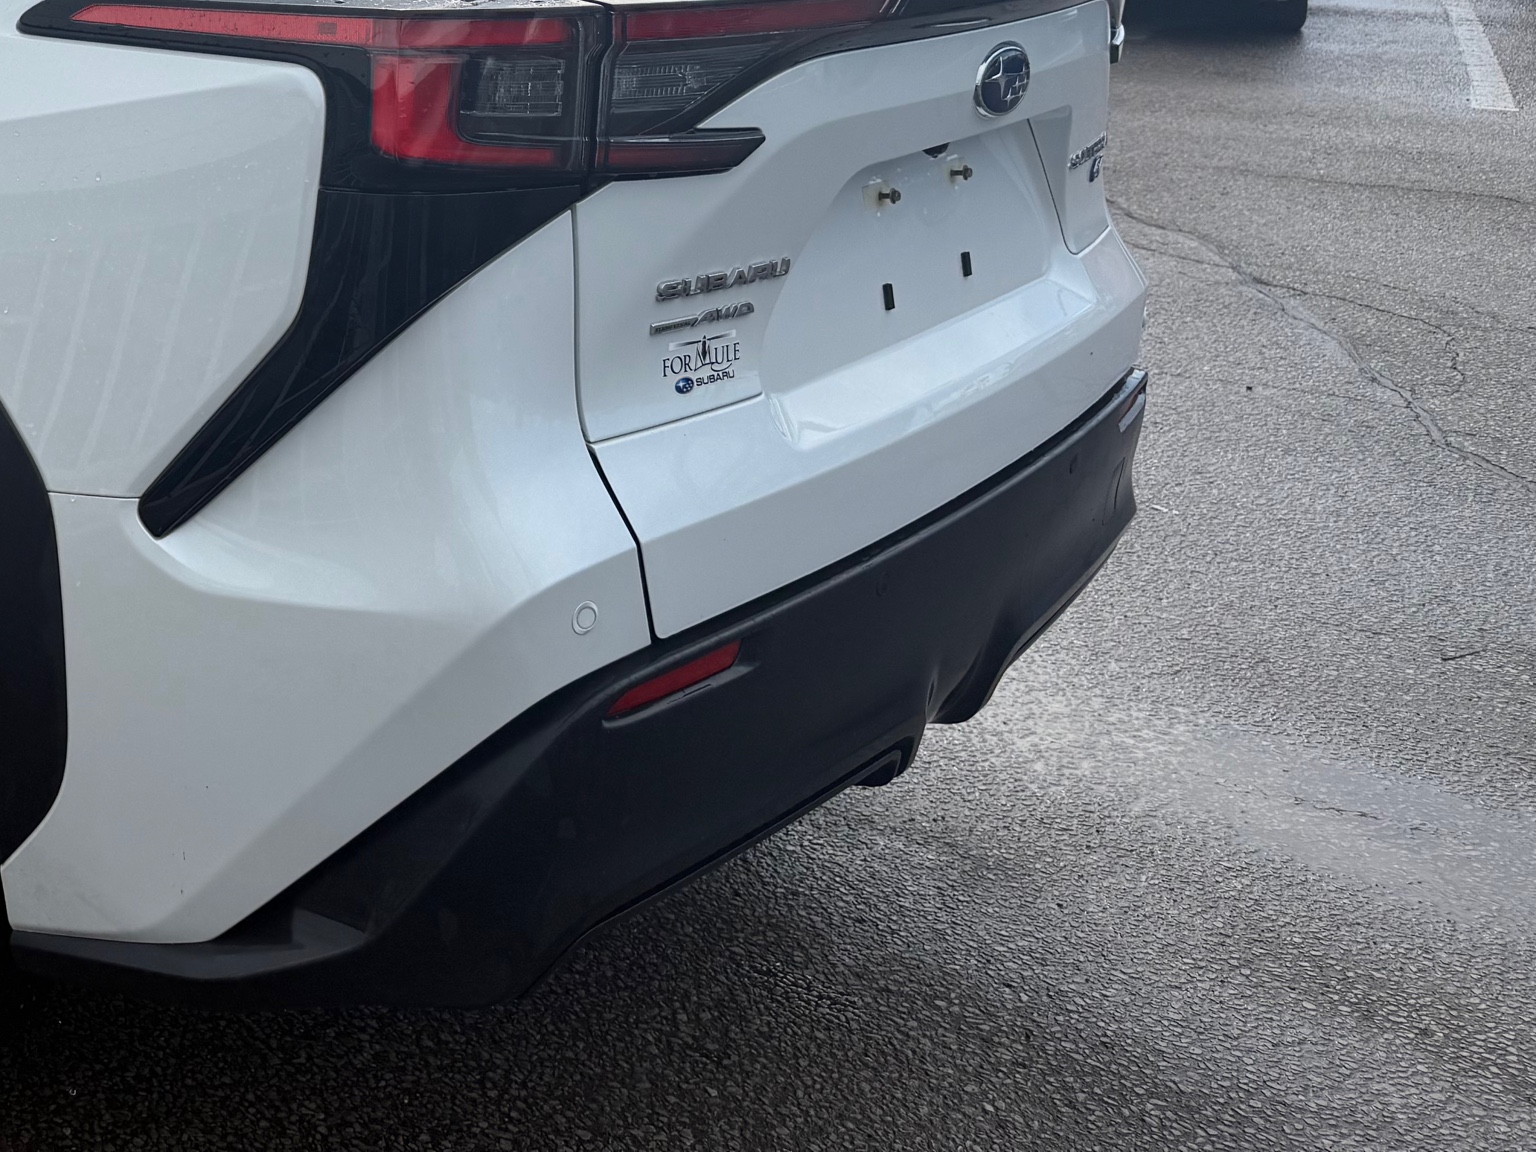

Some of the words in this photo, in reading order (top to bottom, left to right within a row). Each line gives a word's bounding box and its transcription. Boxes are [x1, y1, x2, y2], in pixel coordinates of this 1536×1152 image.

[655, 256, 791, 302] SUBARU
[695, 301, 755, 327] AWD
[695, 369, 735, 387] SUBARU
